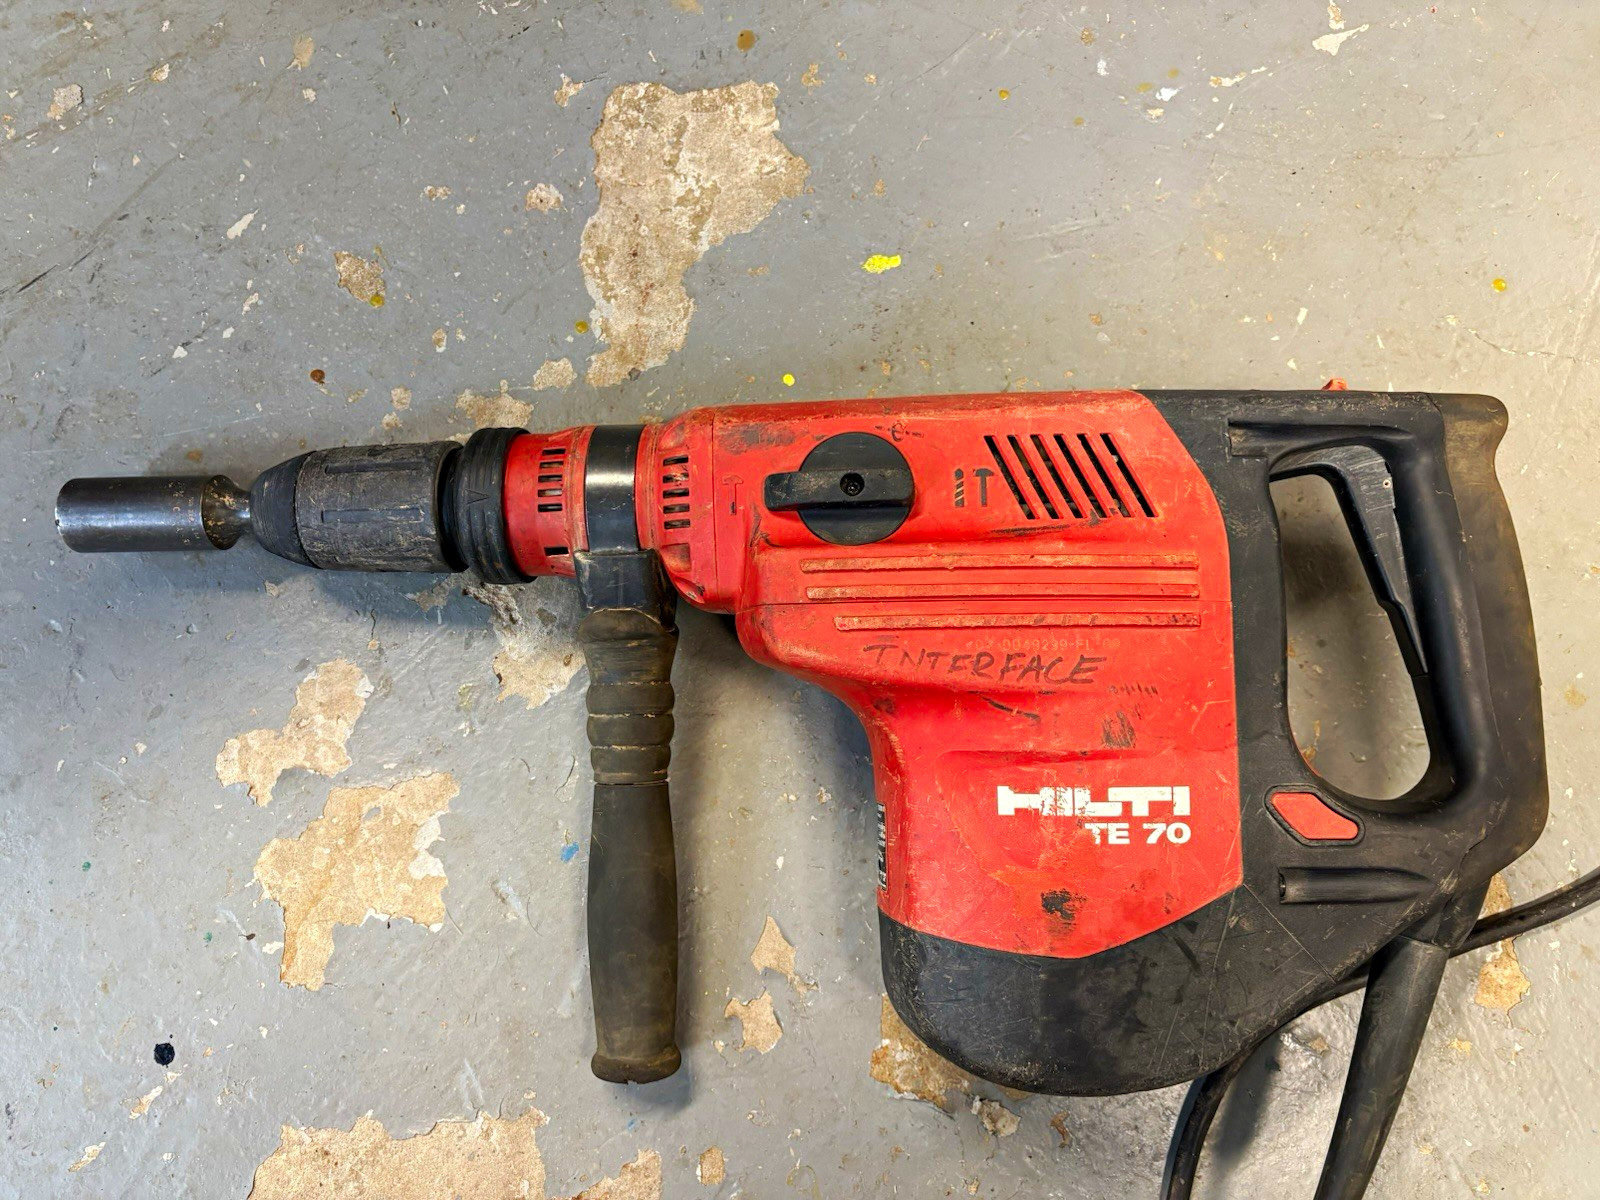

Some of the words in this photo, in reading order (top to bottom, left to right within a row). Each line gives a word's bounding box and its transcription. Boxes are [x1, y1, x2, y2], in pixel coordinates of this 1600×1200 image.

[863, 645, 1106, 684] INTERFACE
[997, 785, 1190, 816] HILTI
[1085, 822, 1130, 844] TE
[1143, 822, 1191, 844] 70
